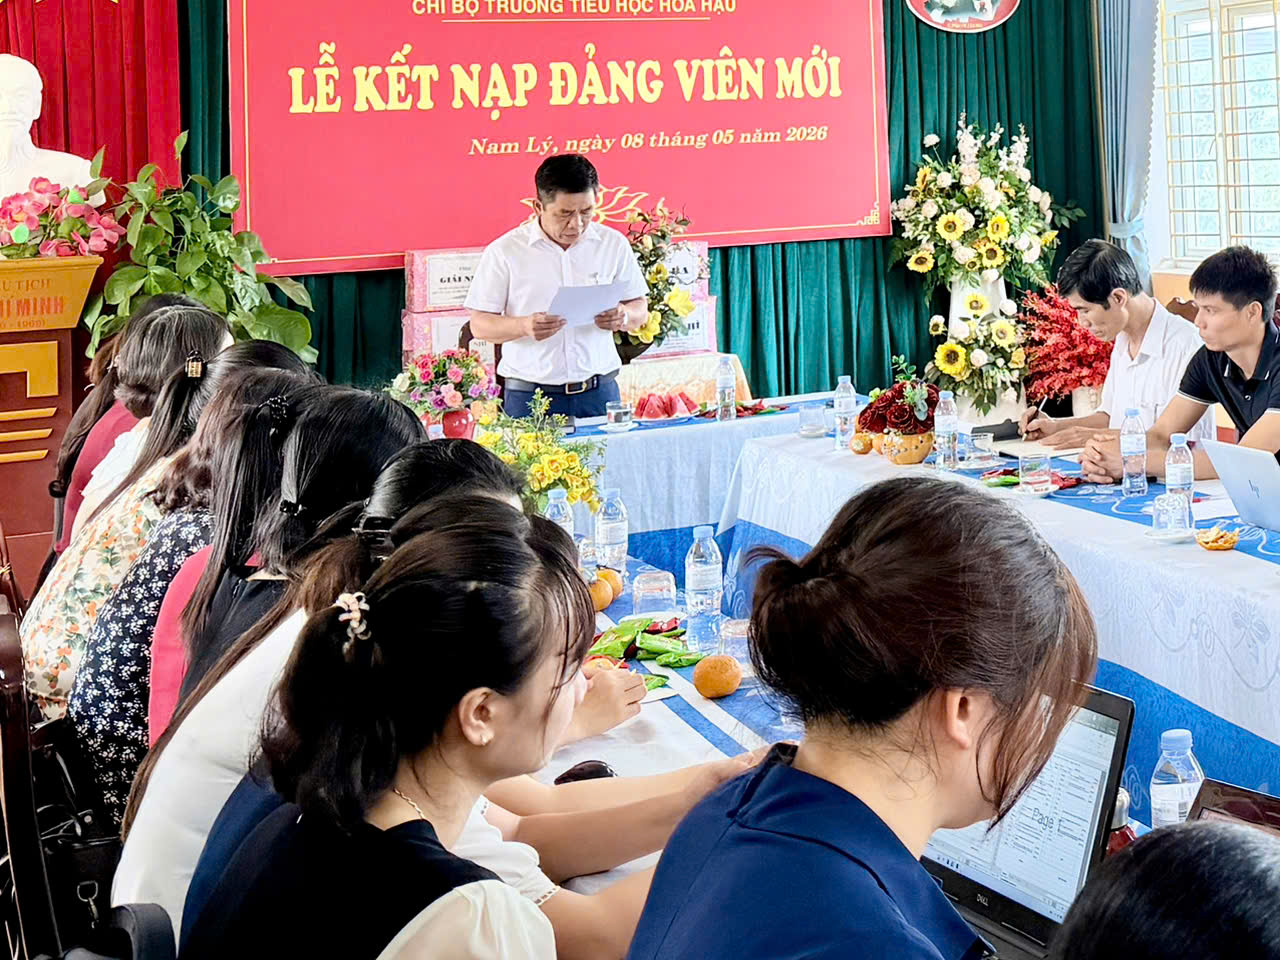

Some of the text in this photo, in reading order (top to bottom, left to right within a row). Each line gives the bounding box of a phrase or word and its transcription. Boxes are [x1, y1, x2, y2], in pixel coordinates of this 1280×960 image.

[288, 41, 842, 120] LỄ KẾT NẠP ĐẢNG VIÊN MỚI
[469, 126, 828, 155] Nam Lý, ngày 08 tháng 05 năm 2026
[1032, 807, 1055, 832] Page
